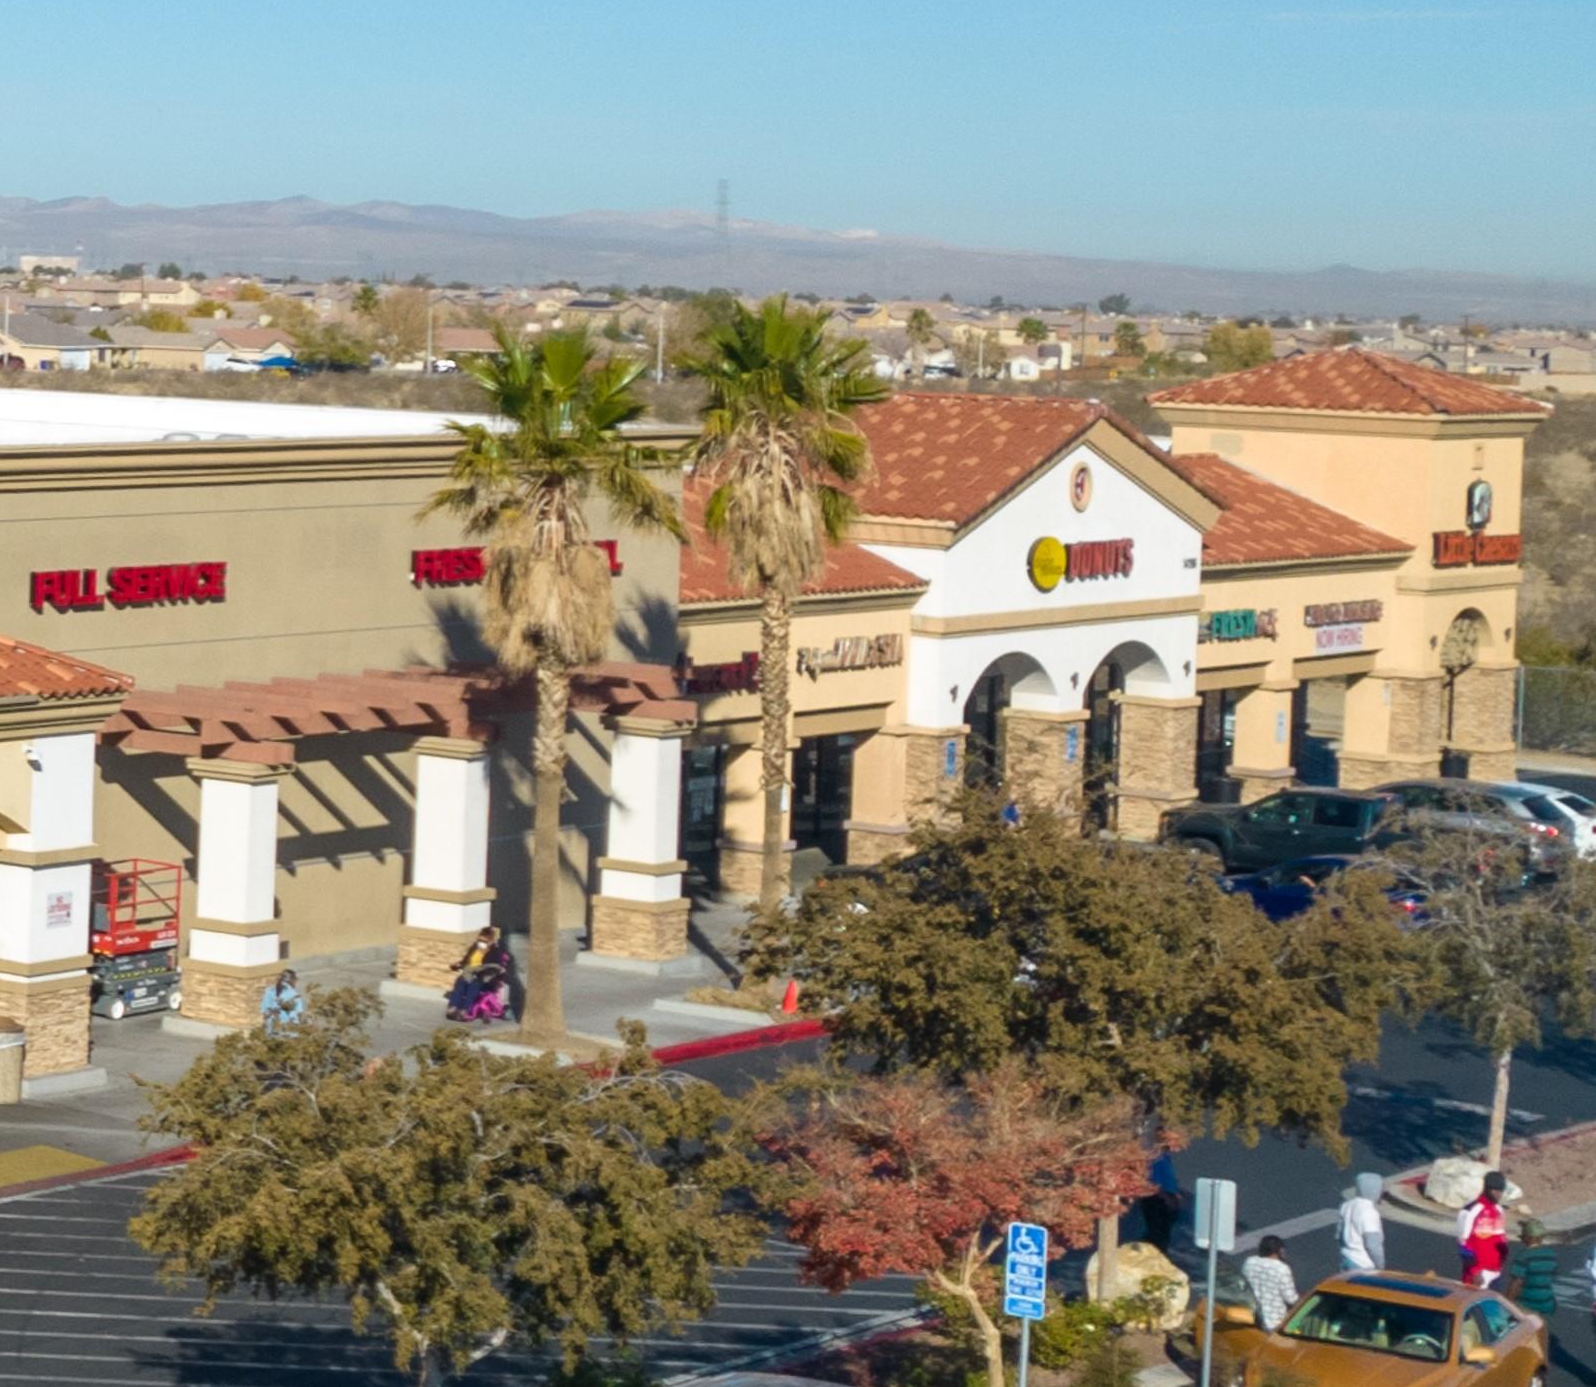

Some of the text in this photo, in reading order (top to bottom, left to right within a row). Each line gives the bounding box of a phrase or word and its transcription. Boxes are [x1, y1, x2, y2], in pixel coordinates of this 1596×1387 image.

[1065, 538, 1134, 581] DONUTS
[31, 561, 227, 610] FULL SERVICE
